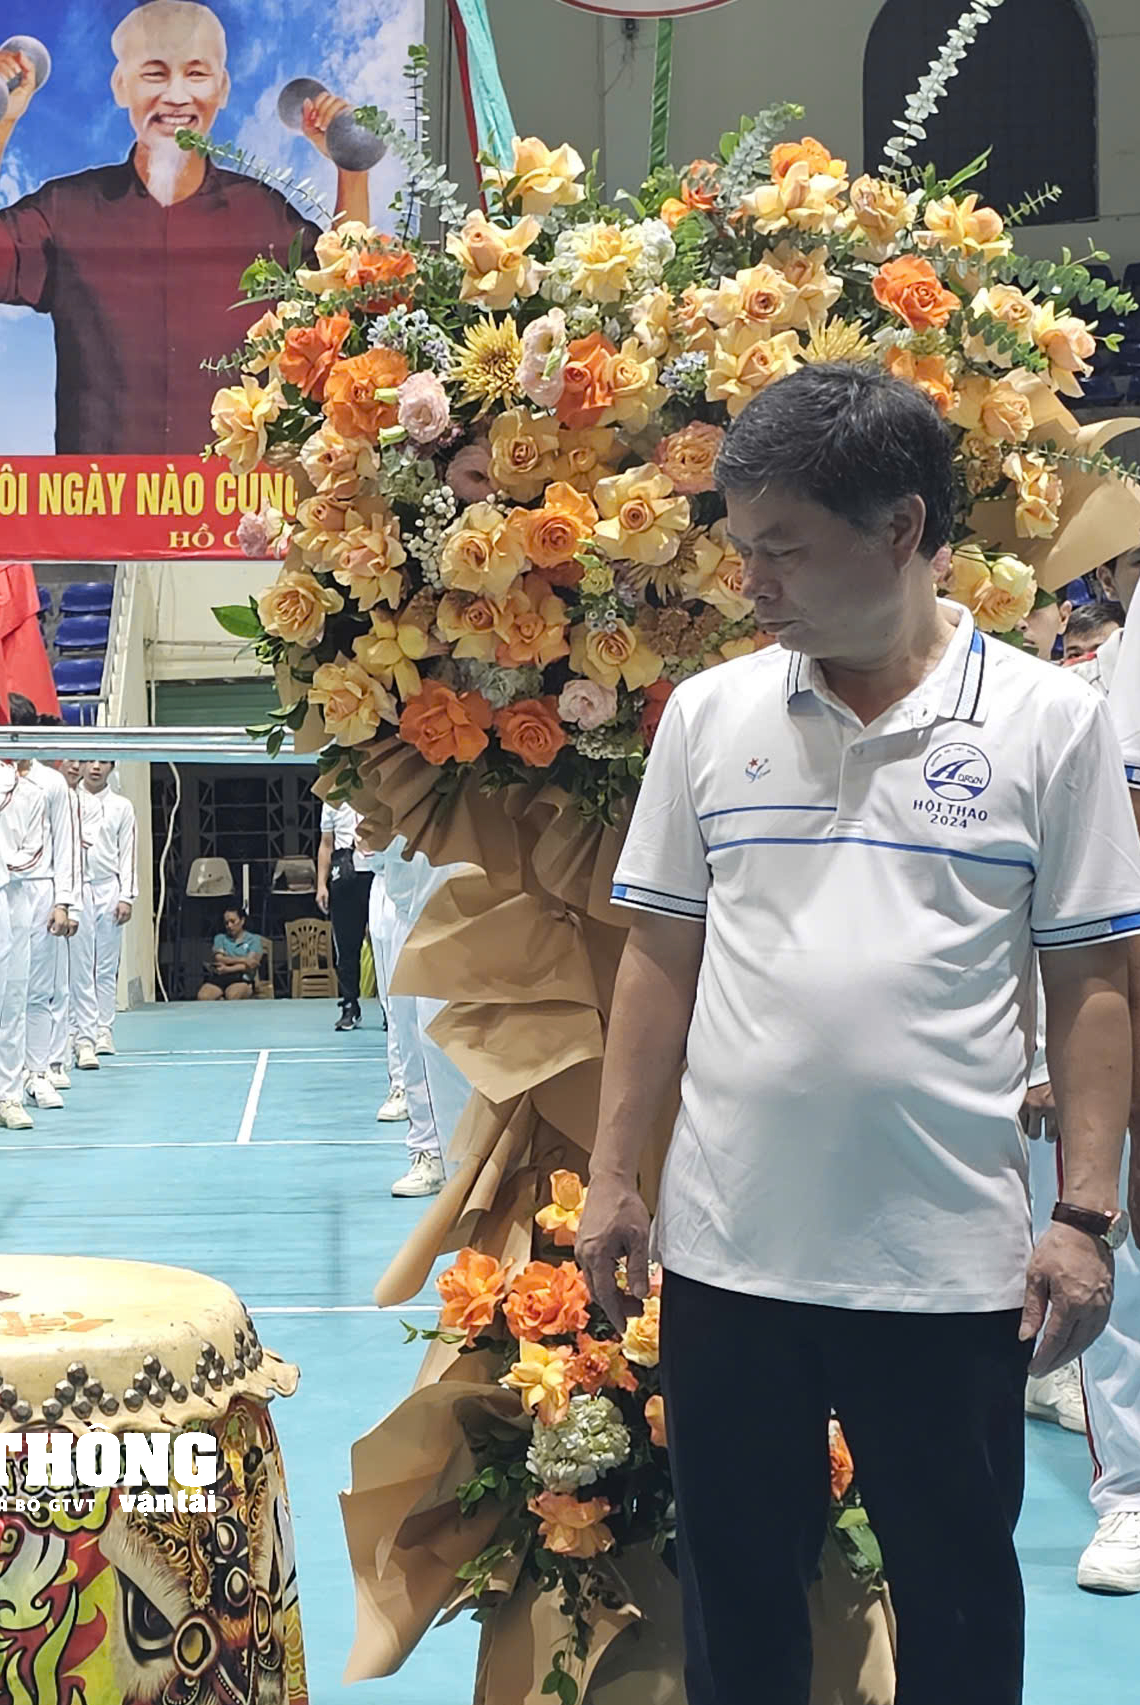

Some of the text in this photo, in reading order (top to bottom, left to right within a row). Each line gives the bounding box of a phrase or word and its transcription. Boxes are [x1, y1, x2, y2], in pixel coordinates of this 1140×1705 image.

[39, 463, 127, 516] NGÀY
[136, 463, 204, 516] NÀO
[169, 523, 216, 550] HỒ
[930, 814, 968, 829] 2024
